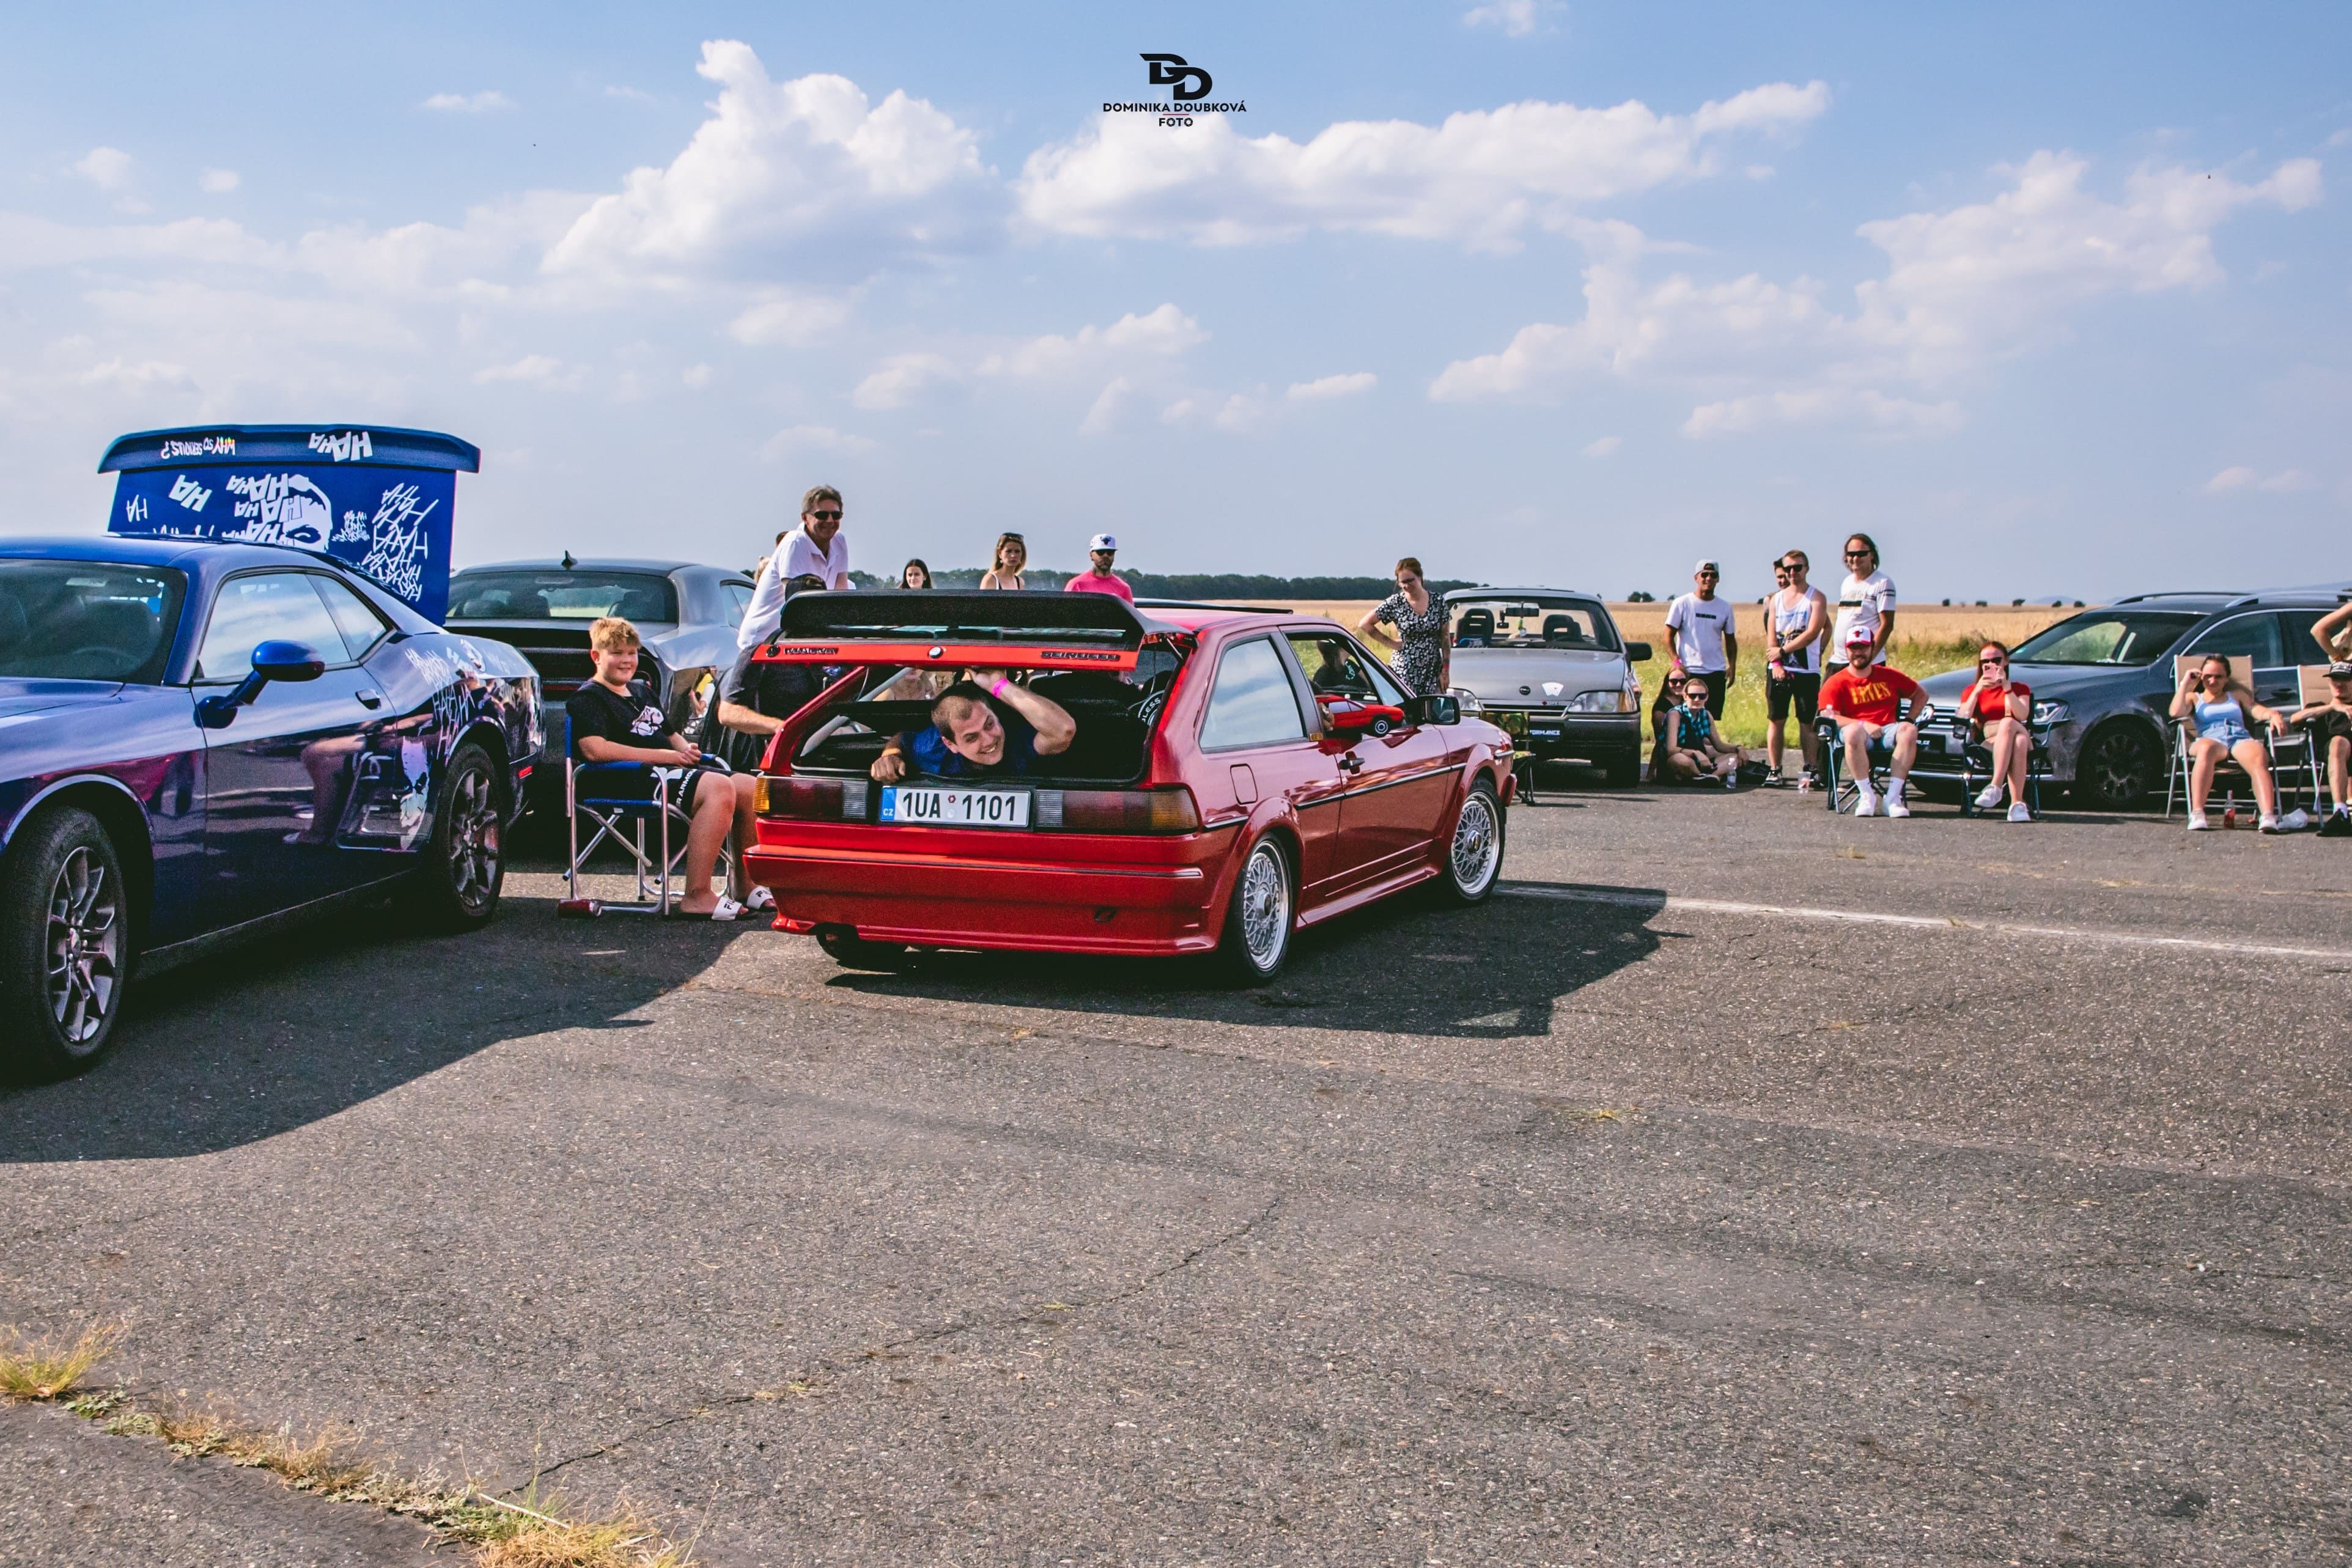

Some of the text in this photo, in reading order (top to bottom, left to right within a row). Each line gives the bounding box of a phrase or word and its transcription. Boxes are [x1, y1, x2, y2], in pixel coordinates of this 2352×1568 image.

[202, 437, 213, 451] SO
[212, 436, 235, 455] WHY
[168, 474, 213, 512] HA
[126, 494, 148, 523] HA
[882, 808, 894, 817] CZ
[902, 792, 1016, 822] 1UA 1101
